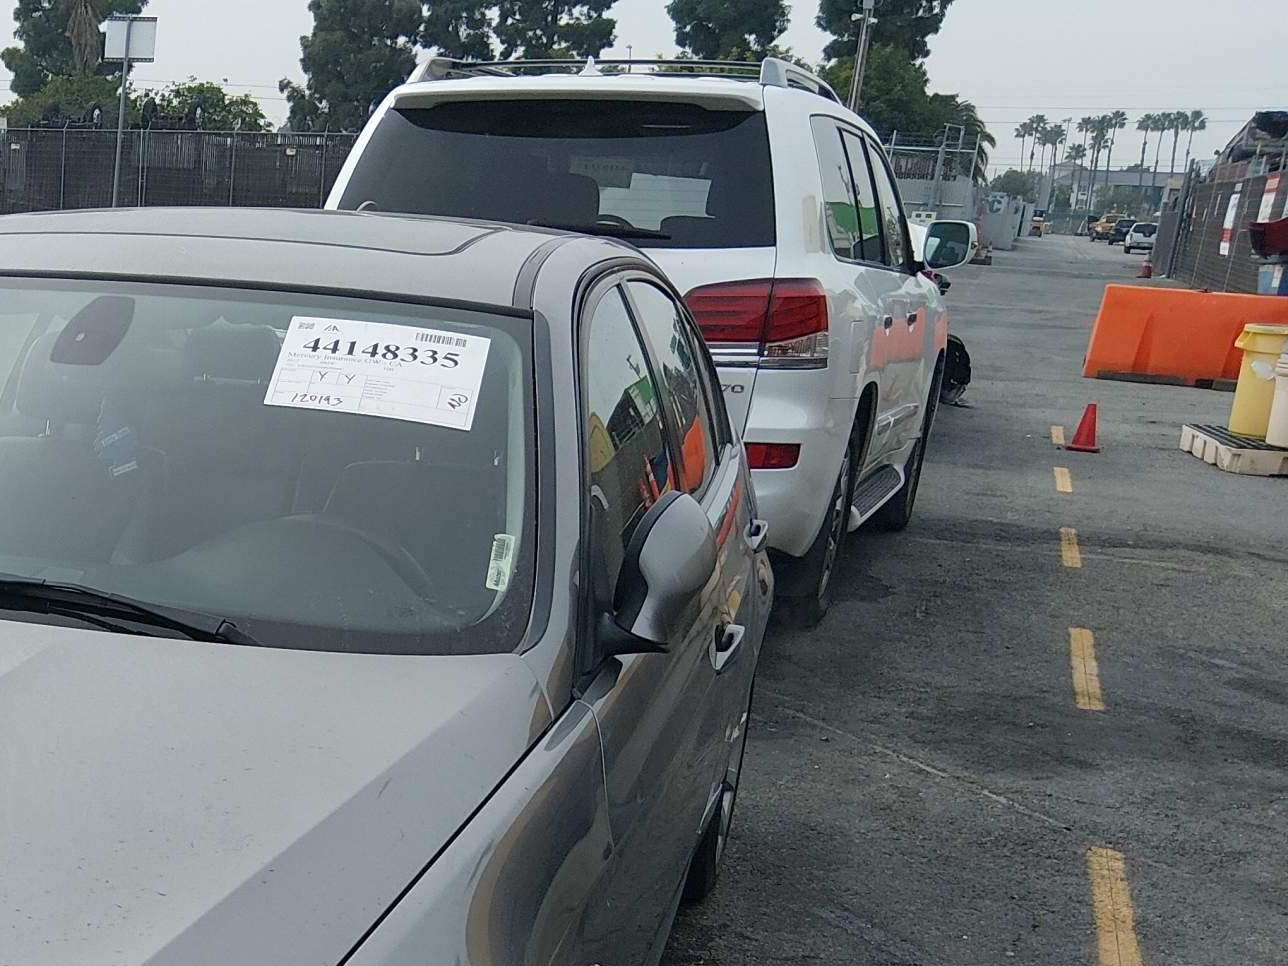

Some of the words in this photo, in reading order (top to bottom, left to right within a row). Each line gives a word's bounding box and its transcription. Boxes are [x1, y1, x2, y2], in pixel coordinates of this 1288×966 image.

[288, 352, 321, 360] Mercury
[323, 354, 362, 363] Insurance
[303, 338, 460, 369] 44148335
[319, 371, 329, 382] Y
[345, 374, 356, 384] Y
